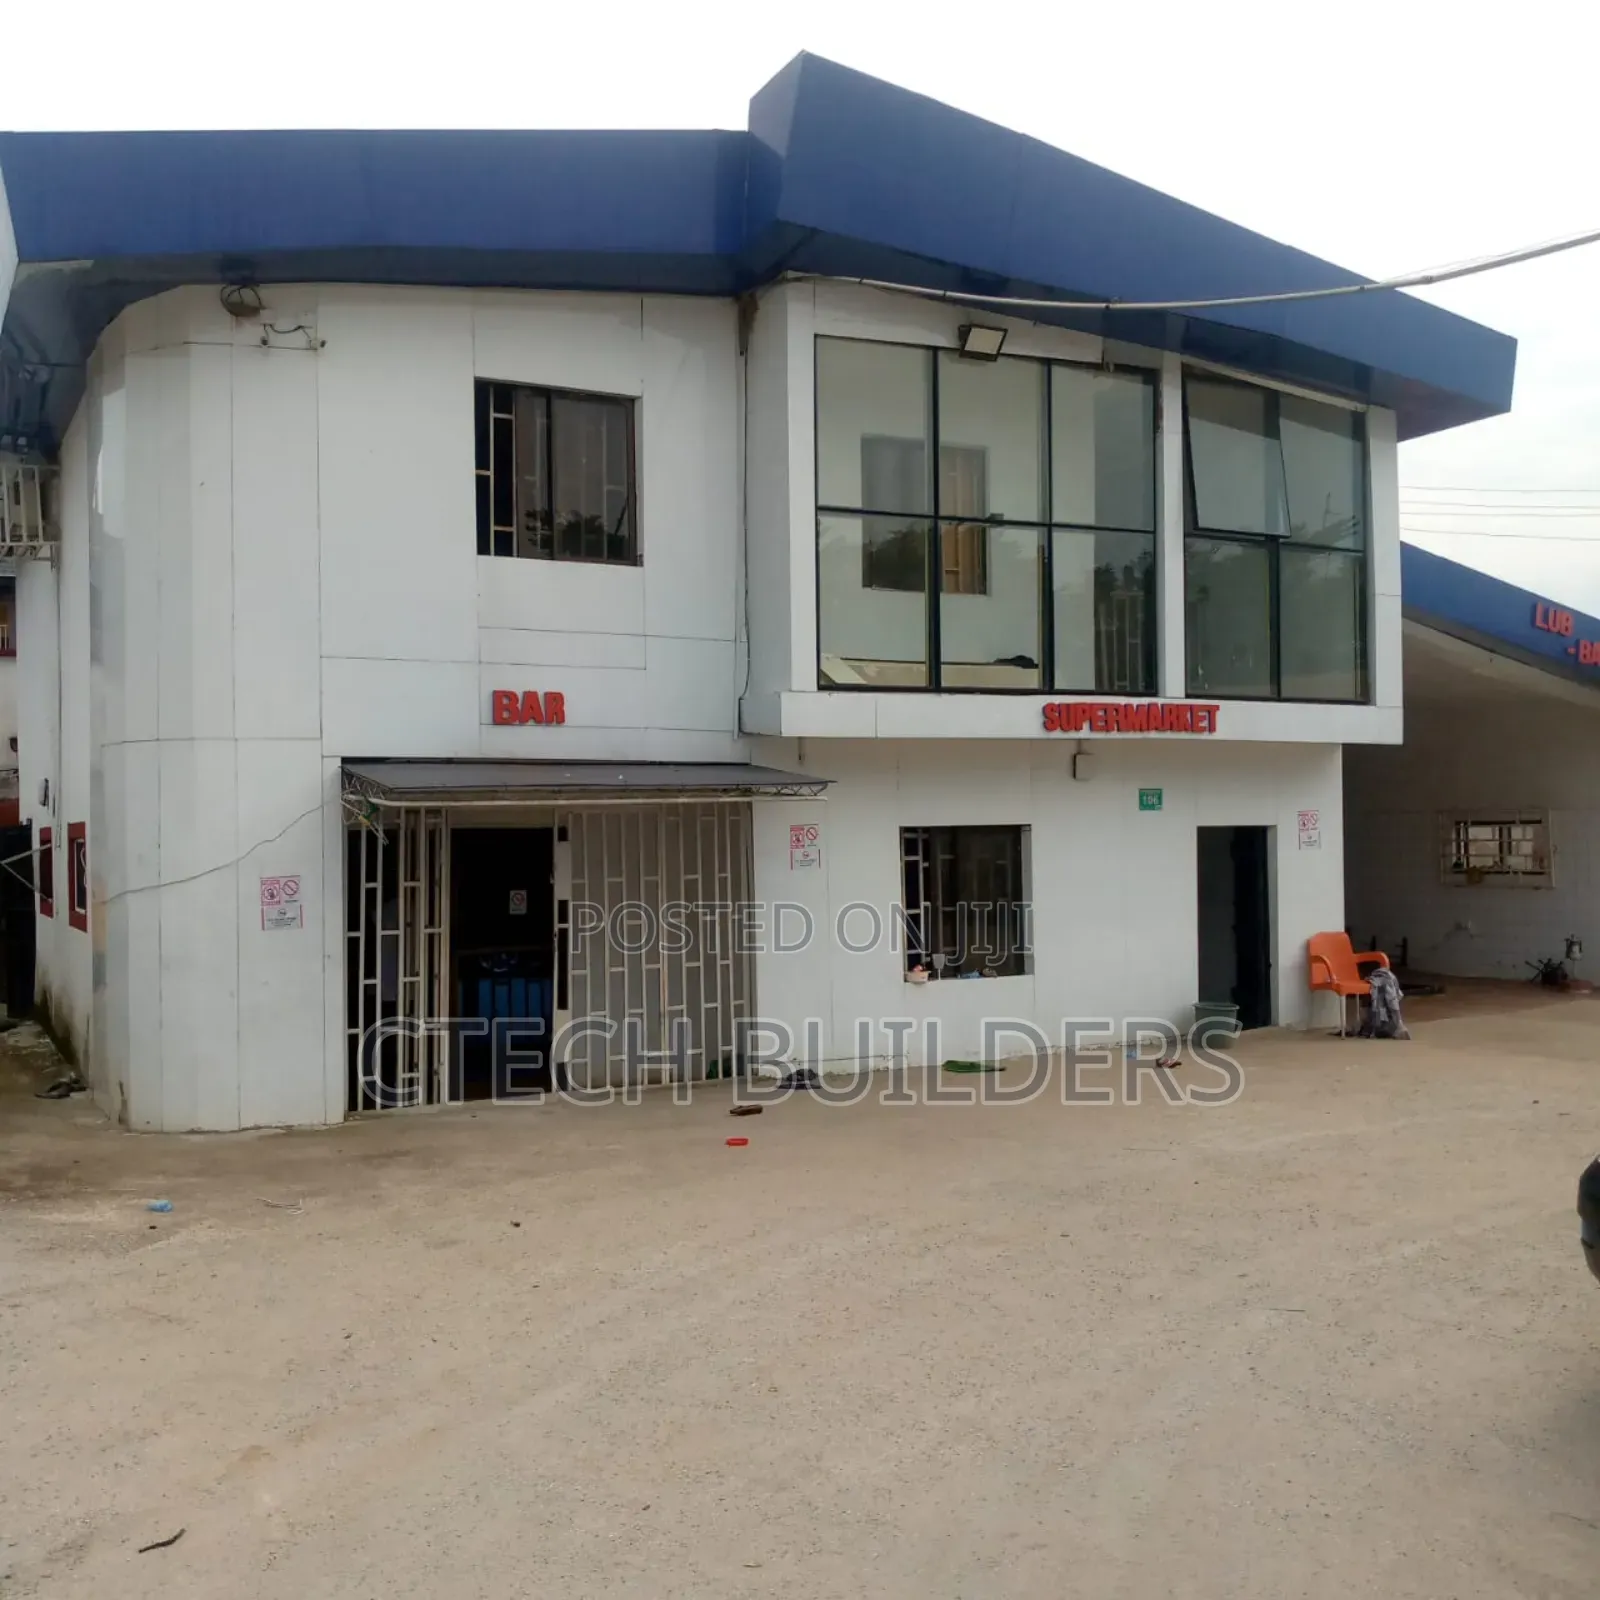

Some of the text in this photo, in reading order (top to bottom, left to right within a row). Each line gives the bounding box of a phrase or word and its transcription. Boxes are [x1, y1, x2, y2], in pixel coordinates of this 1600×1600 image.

[1534, 602, 1573, 637] LUB
[492, 690, 566, 726] BAR
[1042, 702, 1220, 734] SUPERMARKET
